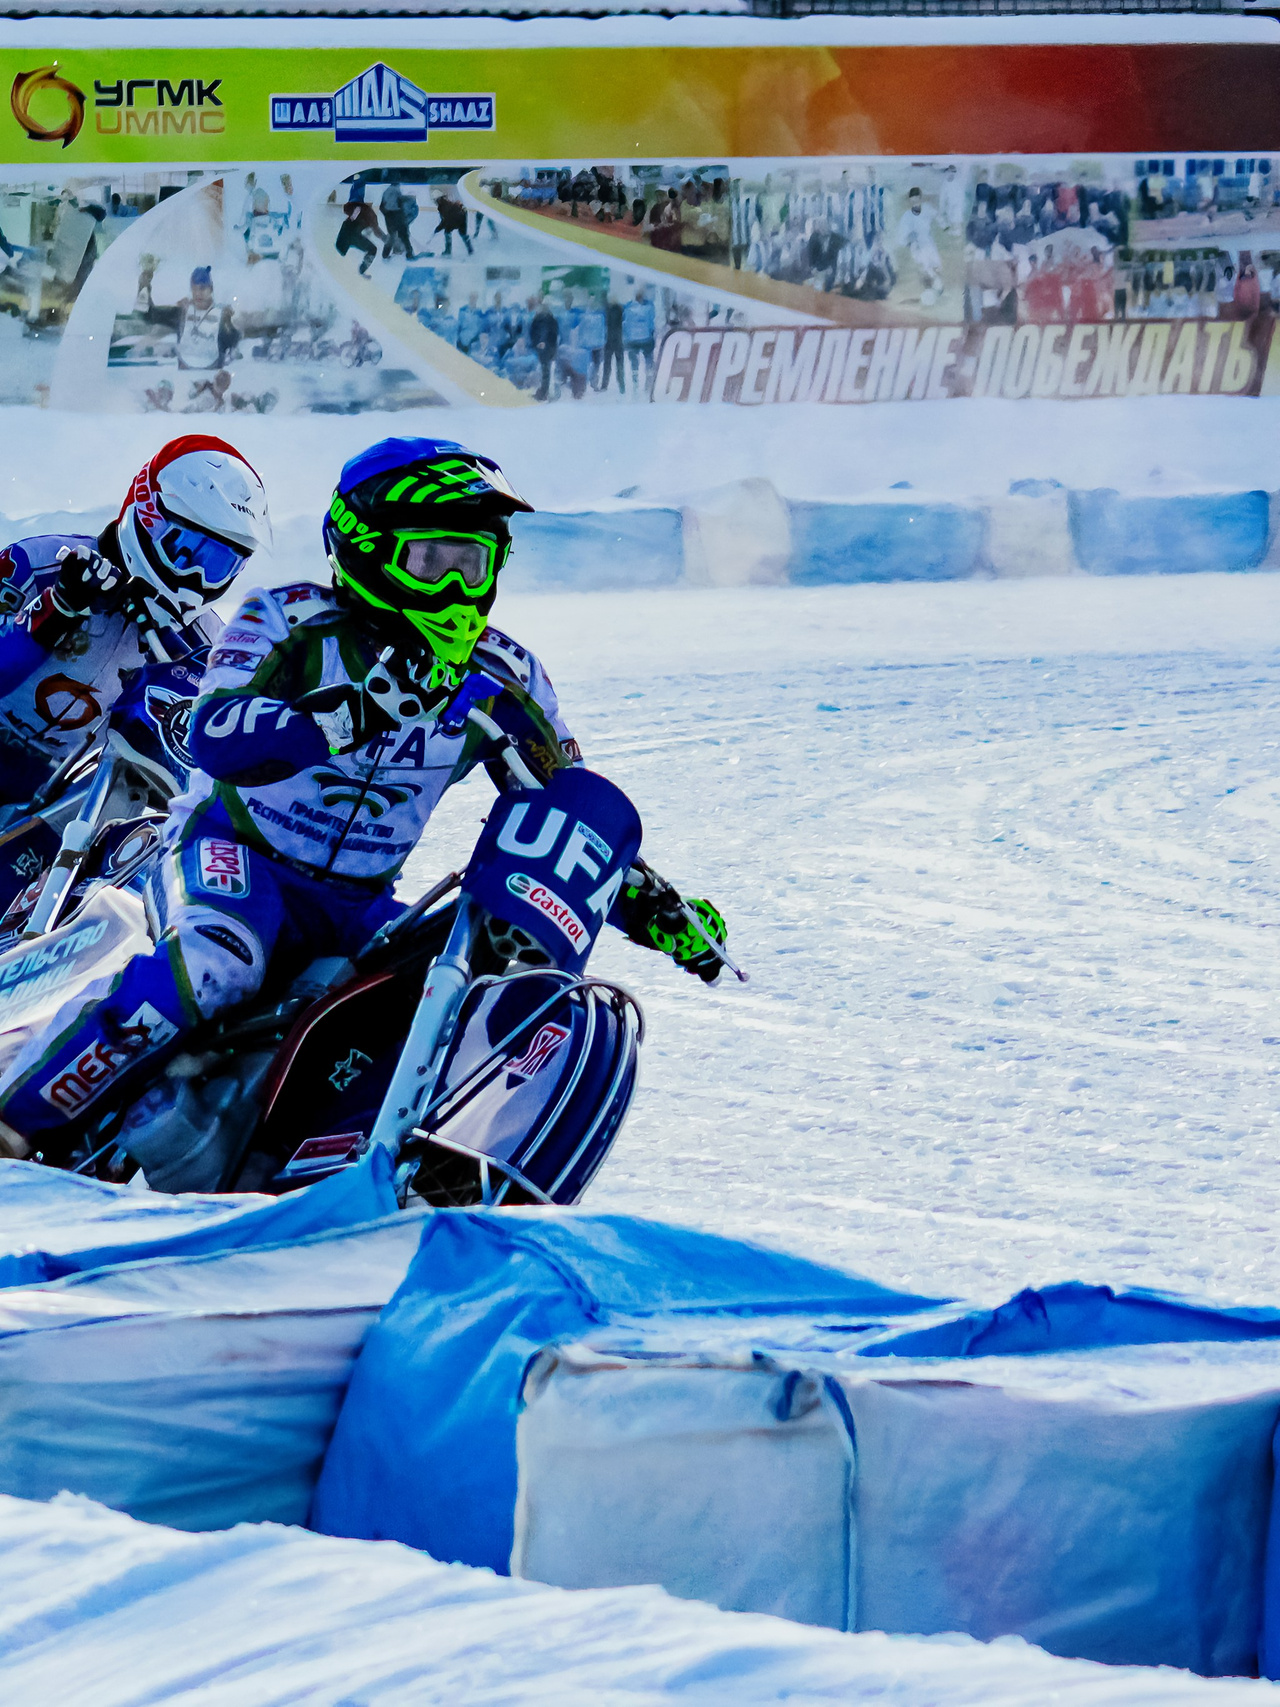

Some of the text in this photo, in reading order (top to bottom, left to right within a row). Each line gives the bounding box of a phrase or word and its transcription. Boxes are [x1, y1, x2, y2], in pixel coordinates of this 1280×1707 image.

[94, 79, 223, 106] УГМК
[430, 102, 491, 123] SHAAZ
[96, 110, 225, 134] UMMC
[653, 320, 1254, 403] СТРЕМЛЕНИЕ ПОБЕЖДАТЬ
[365, 726, 426, 768] FA
[497, 802, 624, 922] UFA
[529, 887, 584, 943] Castrol
